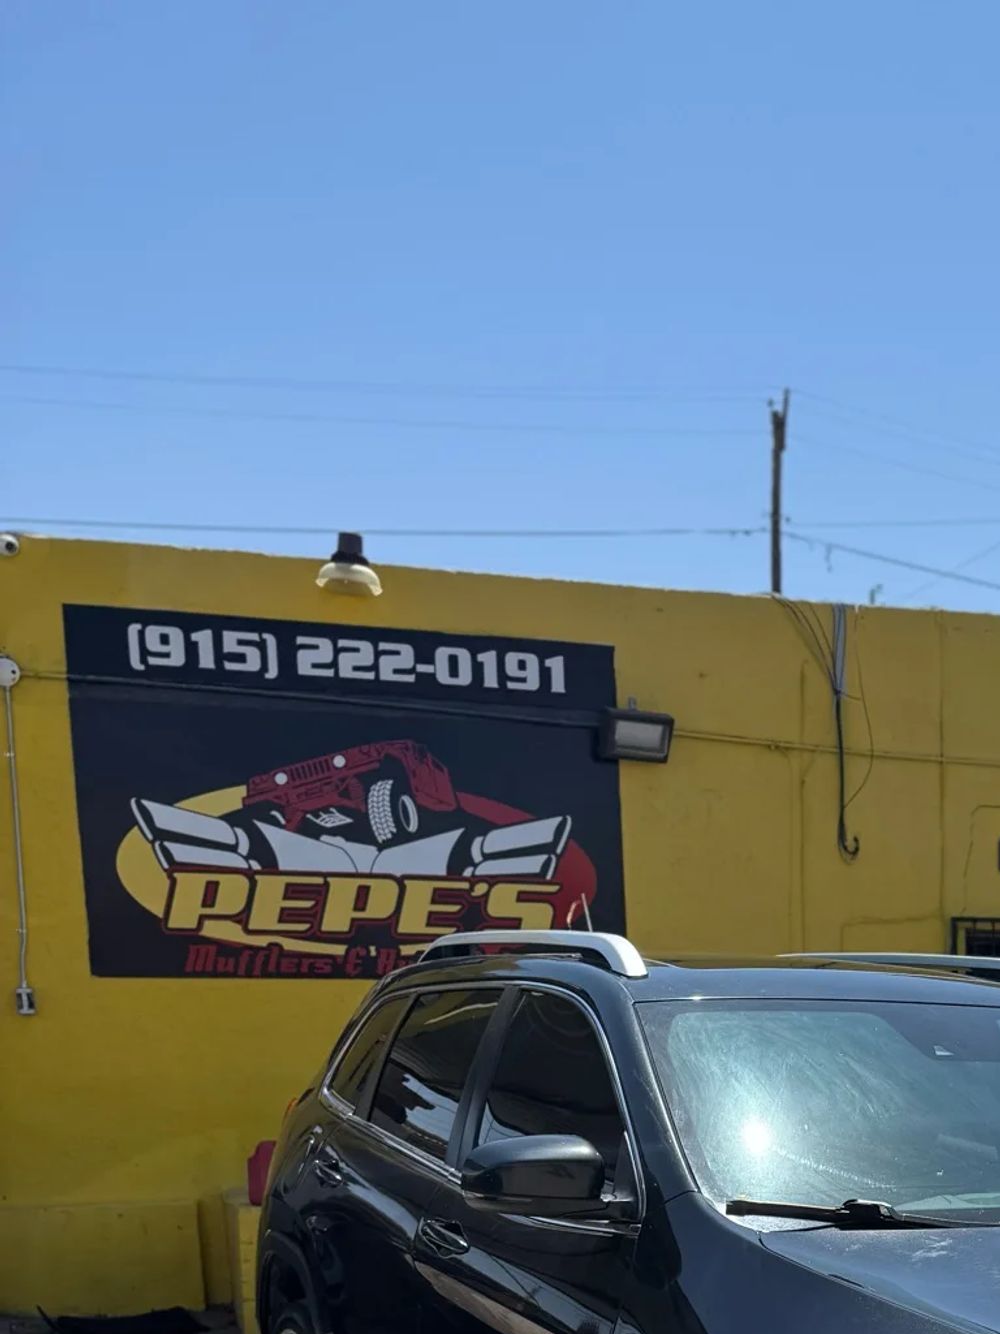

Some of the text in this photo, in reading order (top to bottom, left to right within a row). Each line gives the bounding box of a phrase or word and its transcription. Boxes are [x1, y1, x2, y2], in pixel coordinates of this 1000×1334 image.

[127, 623, 567, 693] (915) 222-0191
[166, 872, 562, 935] PEPE'S
[184, 943, 334, 976] Mufflers
